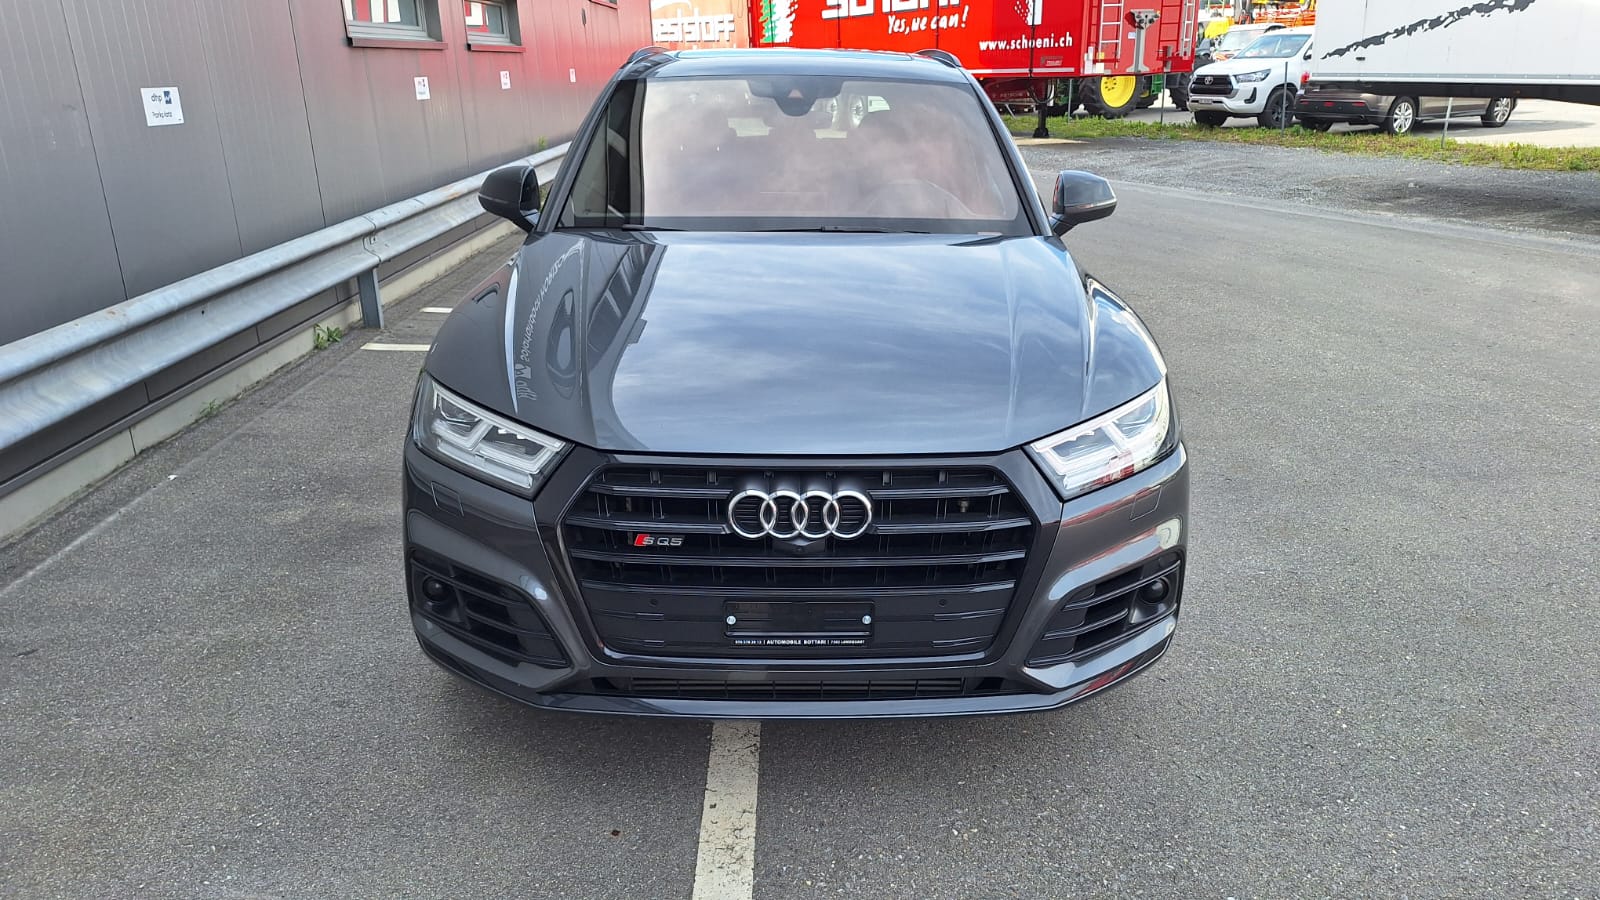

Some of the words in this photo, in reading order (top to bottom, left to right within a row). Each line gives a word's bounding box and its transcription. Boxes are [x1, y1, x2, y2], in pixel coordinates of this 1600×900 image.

[888, 15, 909, 35] Yes,
[911, 16, 927, 31] we
[930, 5, 969, 30] can!
[979, 31, 1073, 51] www.schoeni.ch
[640, 535, 684, 547] SQ5
